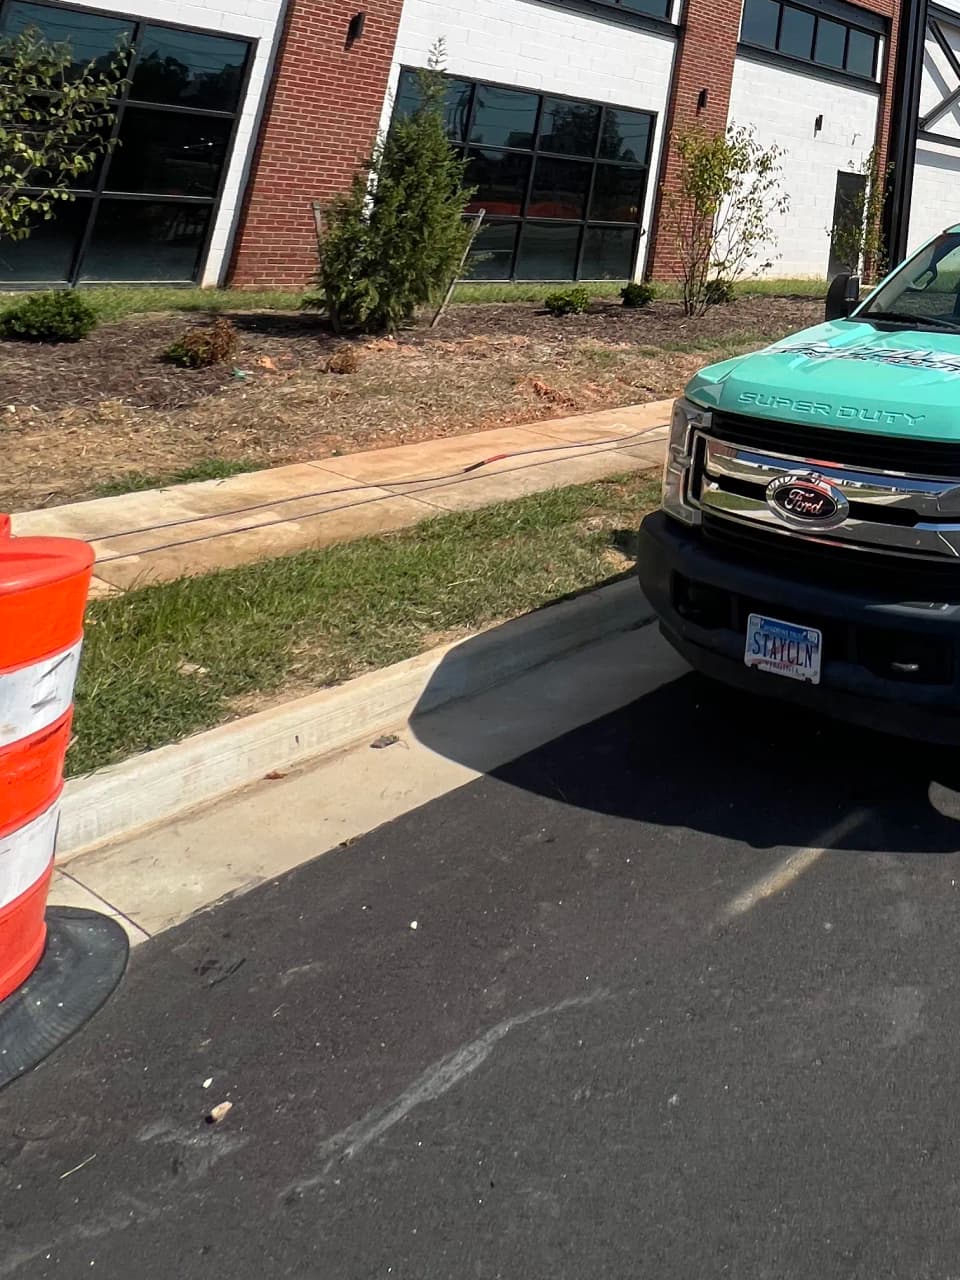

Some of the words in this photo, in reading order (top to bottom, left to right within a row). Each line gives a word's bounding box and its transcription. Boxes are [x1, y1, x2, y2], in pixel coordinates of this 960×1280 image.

[738, 392, 831, 415] SUPER
[835, 406, 926, 426] DUTY
[784, 489, 823, 515] Ford
[752, 631, 813, 669] STAYCLN
